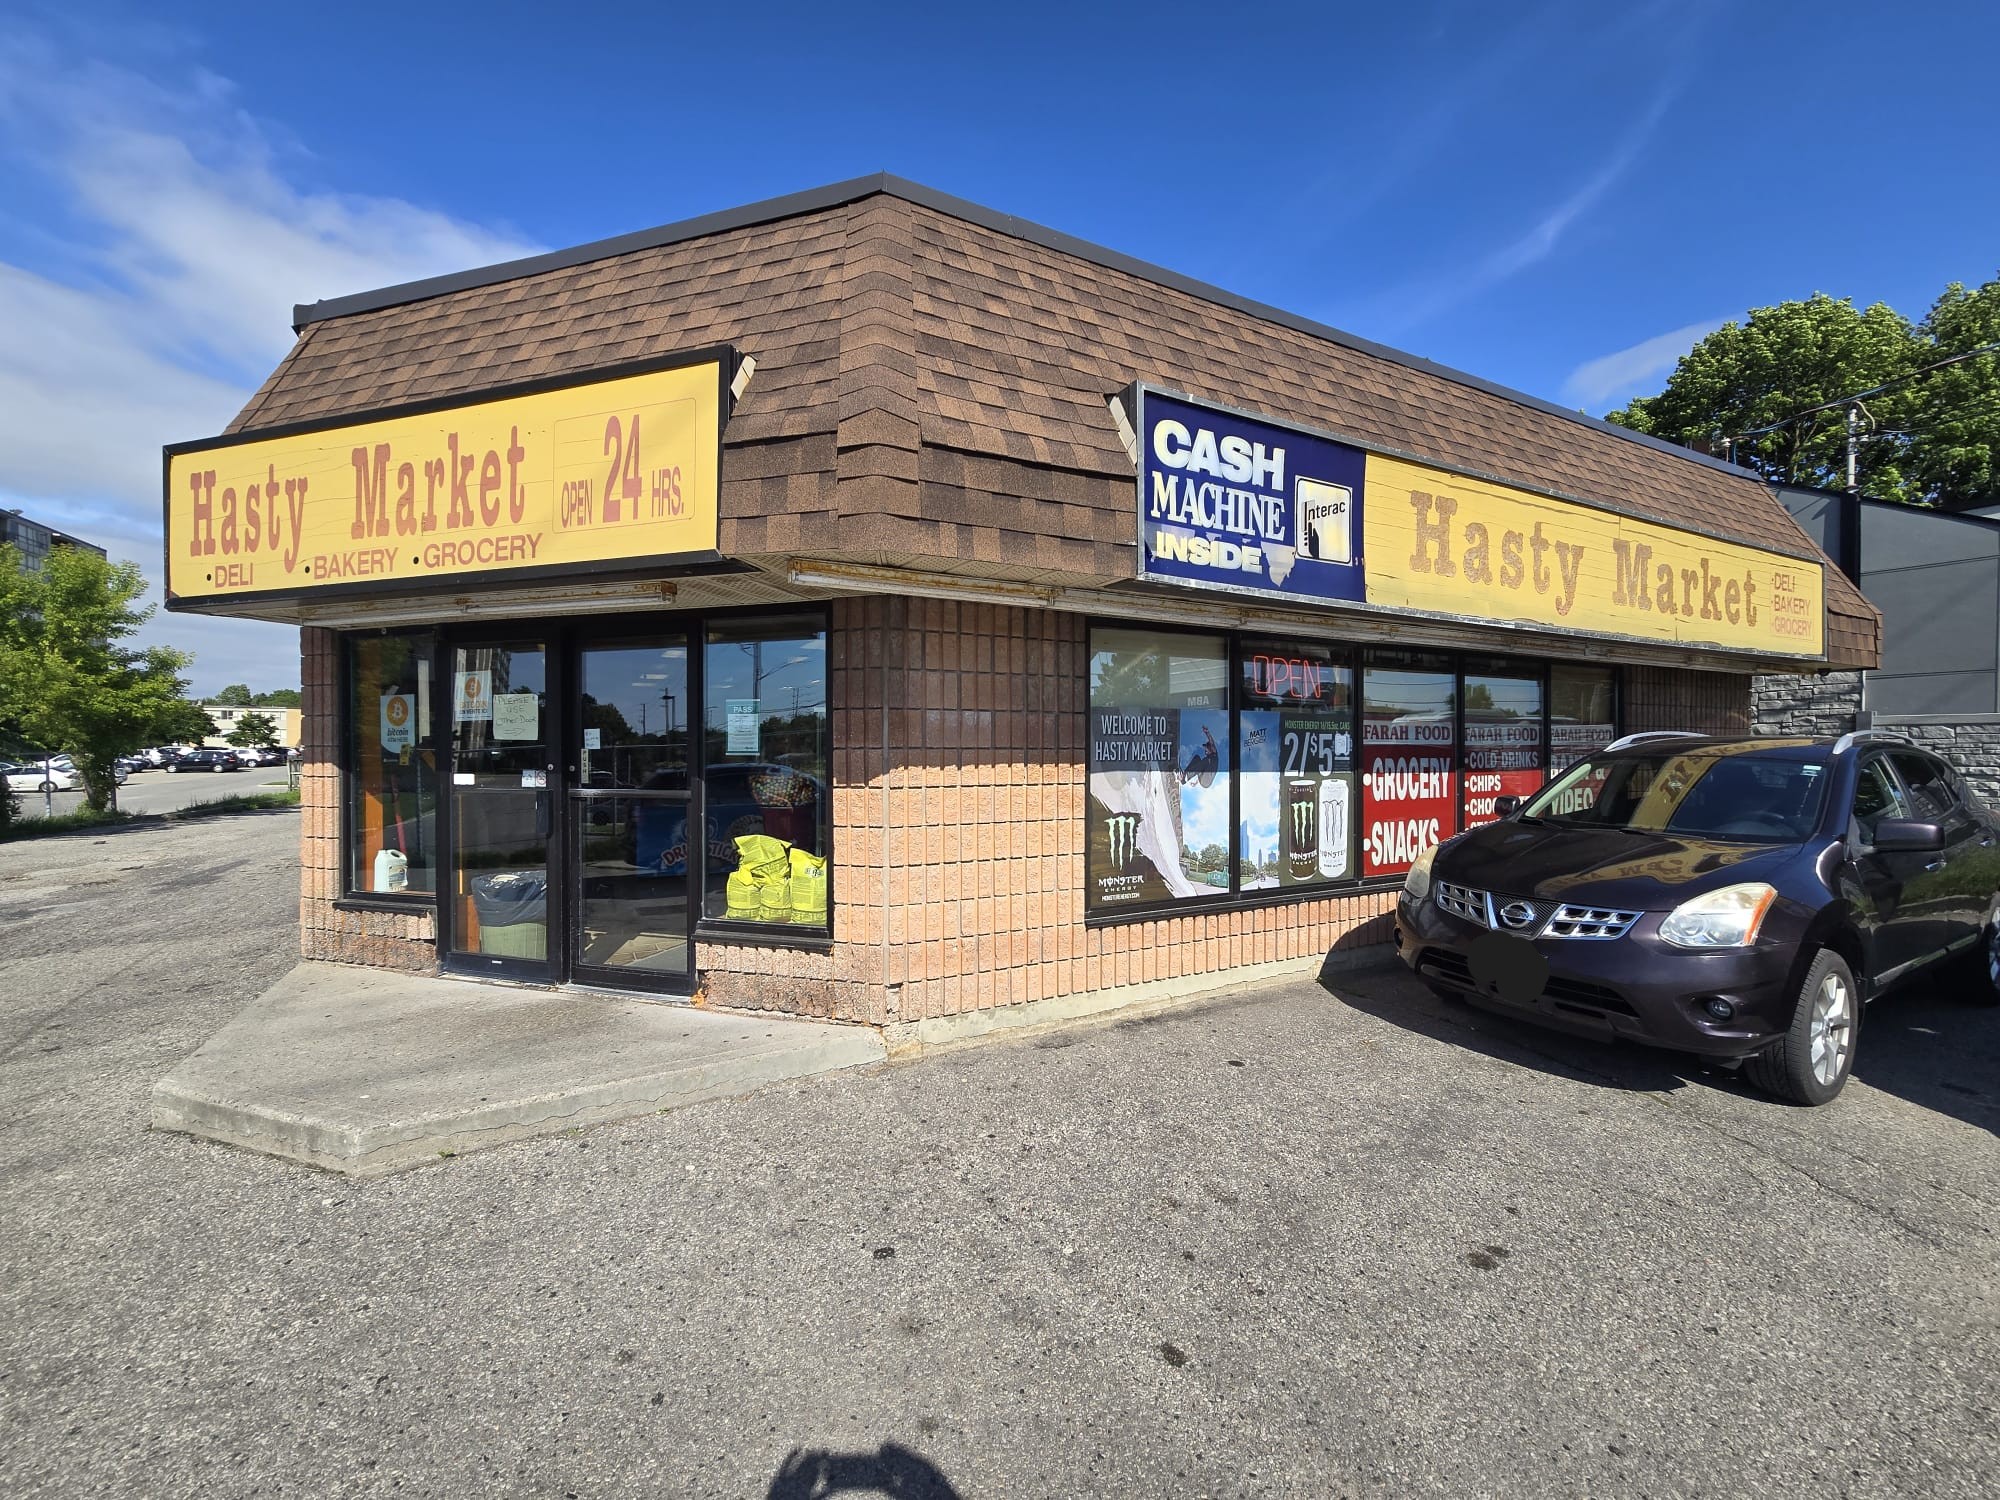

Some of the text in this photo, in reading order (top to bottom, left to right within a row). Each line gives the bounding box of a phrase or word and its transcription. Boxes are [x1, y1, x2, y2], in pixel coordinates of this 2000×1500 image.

[1153, 419, 1285, 491] CASH
[561, 480, 593, 528] OPEN
[602, 414, 642, 524] 24
[190, 425, 526, 574] Hasty Market
[1150, 471, 1285, 541] MACHINE
[1304, 501, 1346, 531] Interac
[214, 532, 543, 588] DELI BAKERY GROCERY
[1155, 531, 1263, 575] INSIDE
[1408, 490, 1757, 627] Hasty Market
[1774, 572, 1795, 592] DELI
[1774, 594, 1811, 616] BAKERY
[1774, 616, 1812, 636] GROCERY
[1253, 655, 1323, 698] OPEN
[506, 705, 525, 714] USE
[1101, 715, 1167, 736] WELCOME TO
[1249, 728, 1267, 738] MATT
[1363, 724, 1451, 740] FARAH FOOD
[1465, 727, 1538, 741] FARAH FOOD
[1095, 741, 1172, 761] HASTY MARKET
[1469, 752, 1497, 769] COLD
[1501, 751, 1538, 768] DRINKS
[1372, 756, 1451, 801] GROCERY
[1469, 775, 1502, 792] CHIPS
[1551, 787, 1593, 815] VIDEO
[1371, 818, 1440, 866] SNACKS
[1098, 875, 1144, 887] MONSTER
